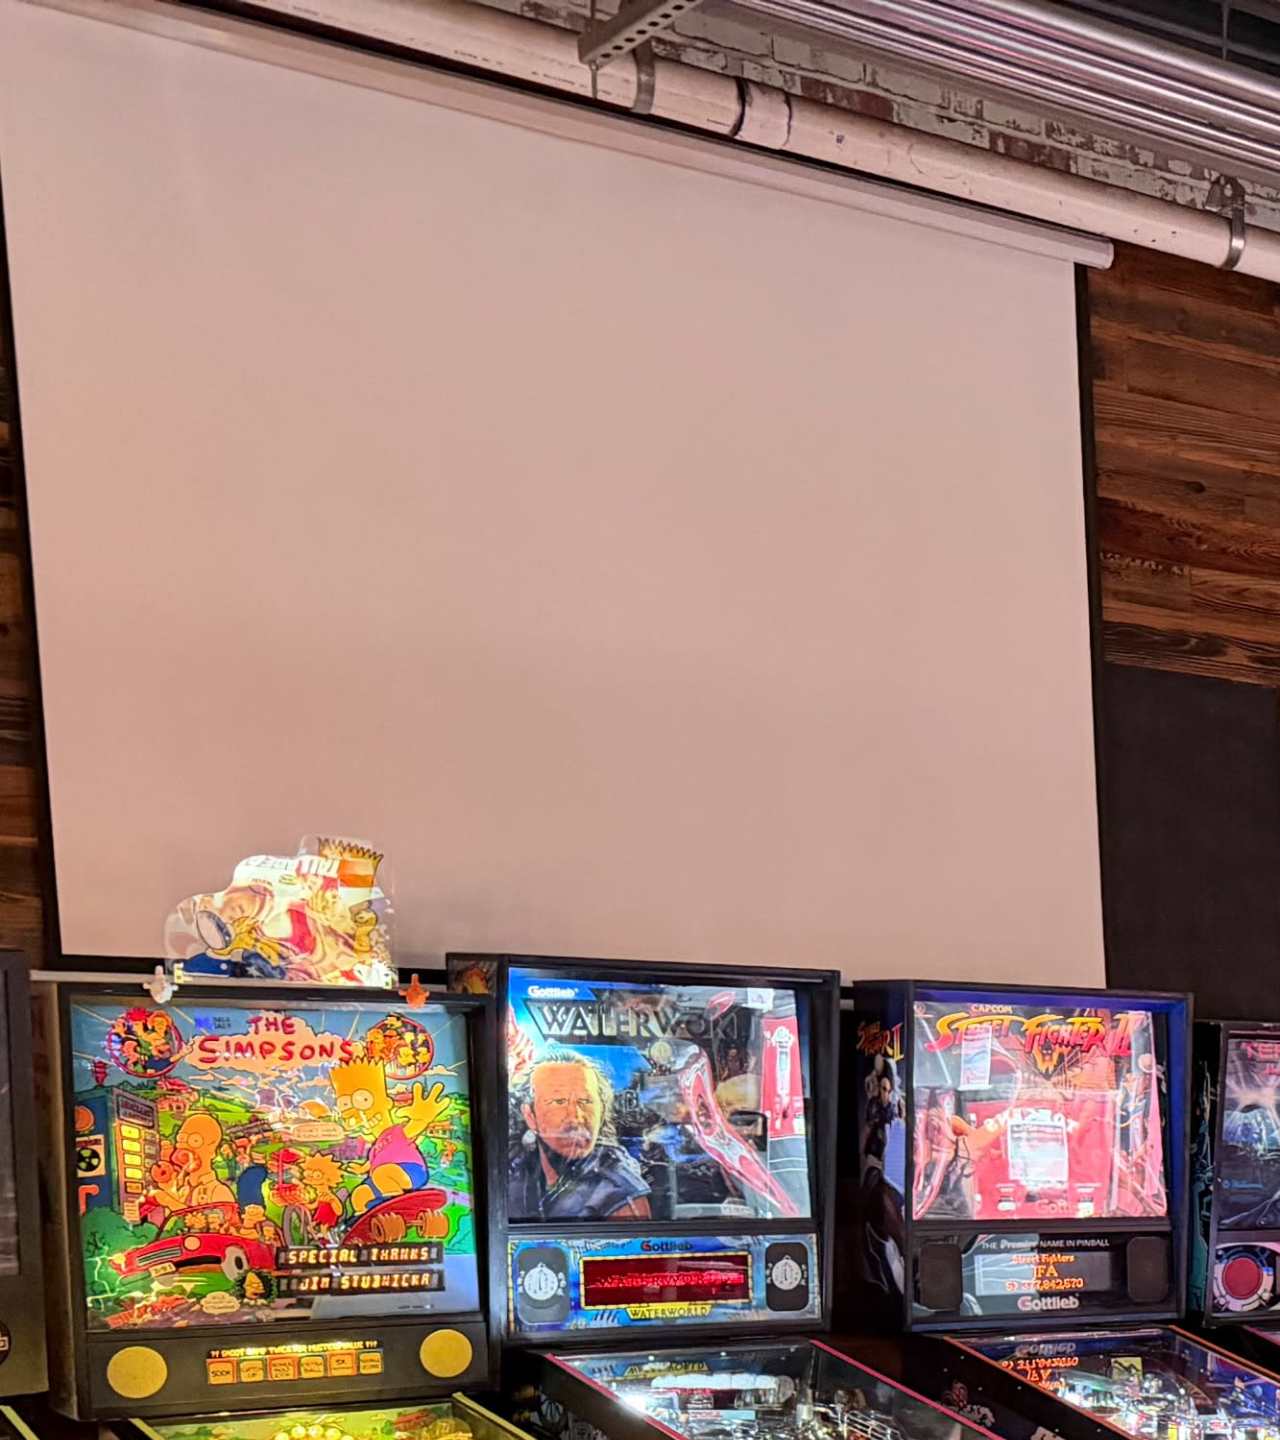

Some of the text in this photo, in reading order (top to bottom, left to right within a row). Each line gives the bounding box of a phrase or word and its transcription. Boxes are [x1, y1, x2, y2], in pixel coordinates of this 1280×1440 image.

[970, 1004, 1013, 1015] CAPCOM
[247, 1015, 296, 1035] THE
[924, 1012, 1020, 1052] STREET
[1019, 1014, 1108, 1052] FIGHTER
[198, 1036, 353, 1064] SIMPSONS
[982, 1242, 997, 1250] THE
[1040, 1240, 1064, 1249] NAME
[1066, 1240, 1075, 1248] IN
[1076, 1239, 1110, 1248] PINBALL
[289, 1247, 429, 1265] SPECIAL THANKS
[1041, 1253, 1075, 1265] Fighters
[1032, 1265, 1059, 1279] JFA
[299, 1276, 331, 1291] JIM
[1017, 1296, 1079, 1312] Gottlieb
[630, 1305, 708, 1319] WATERWORLD
